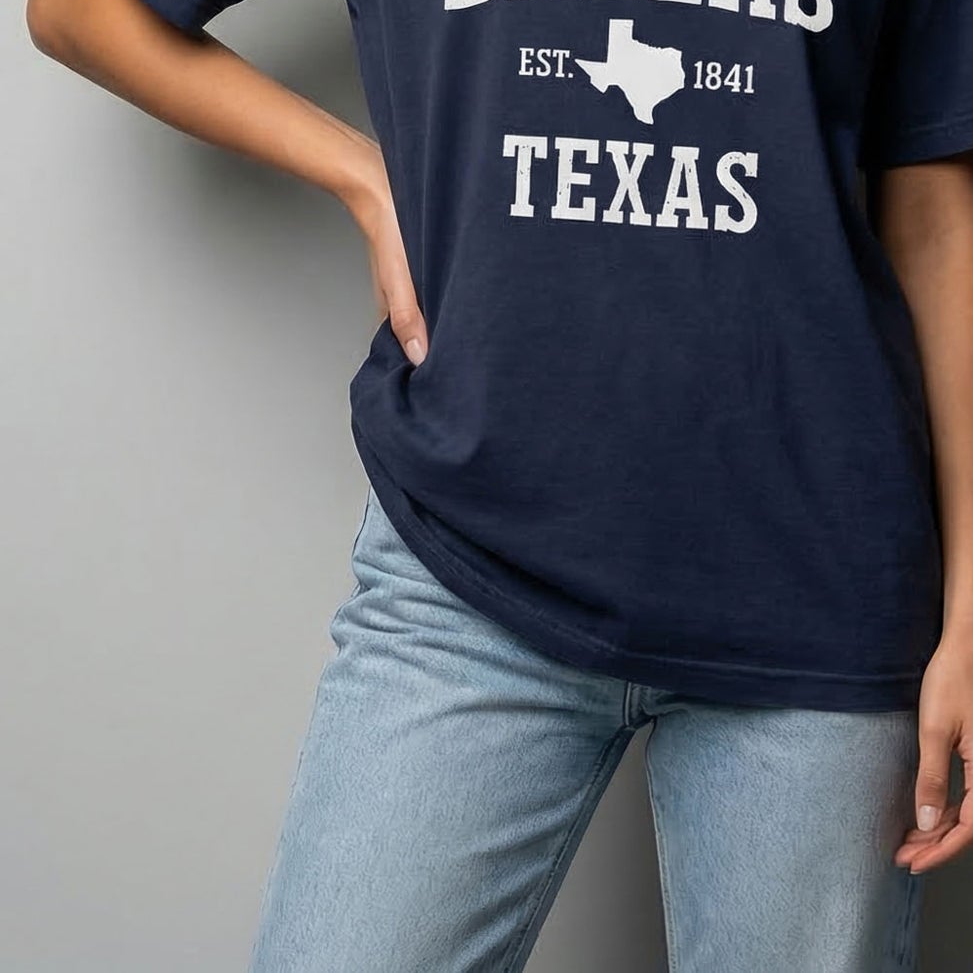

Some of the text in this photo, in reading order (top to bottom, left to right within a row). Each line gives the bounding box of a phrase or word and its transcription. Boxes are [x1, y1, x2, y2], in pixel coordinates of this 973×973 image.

[518, 47, 755, 94] EST. 1841
[502, 134, 759, 234] TEXAS
